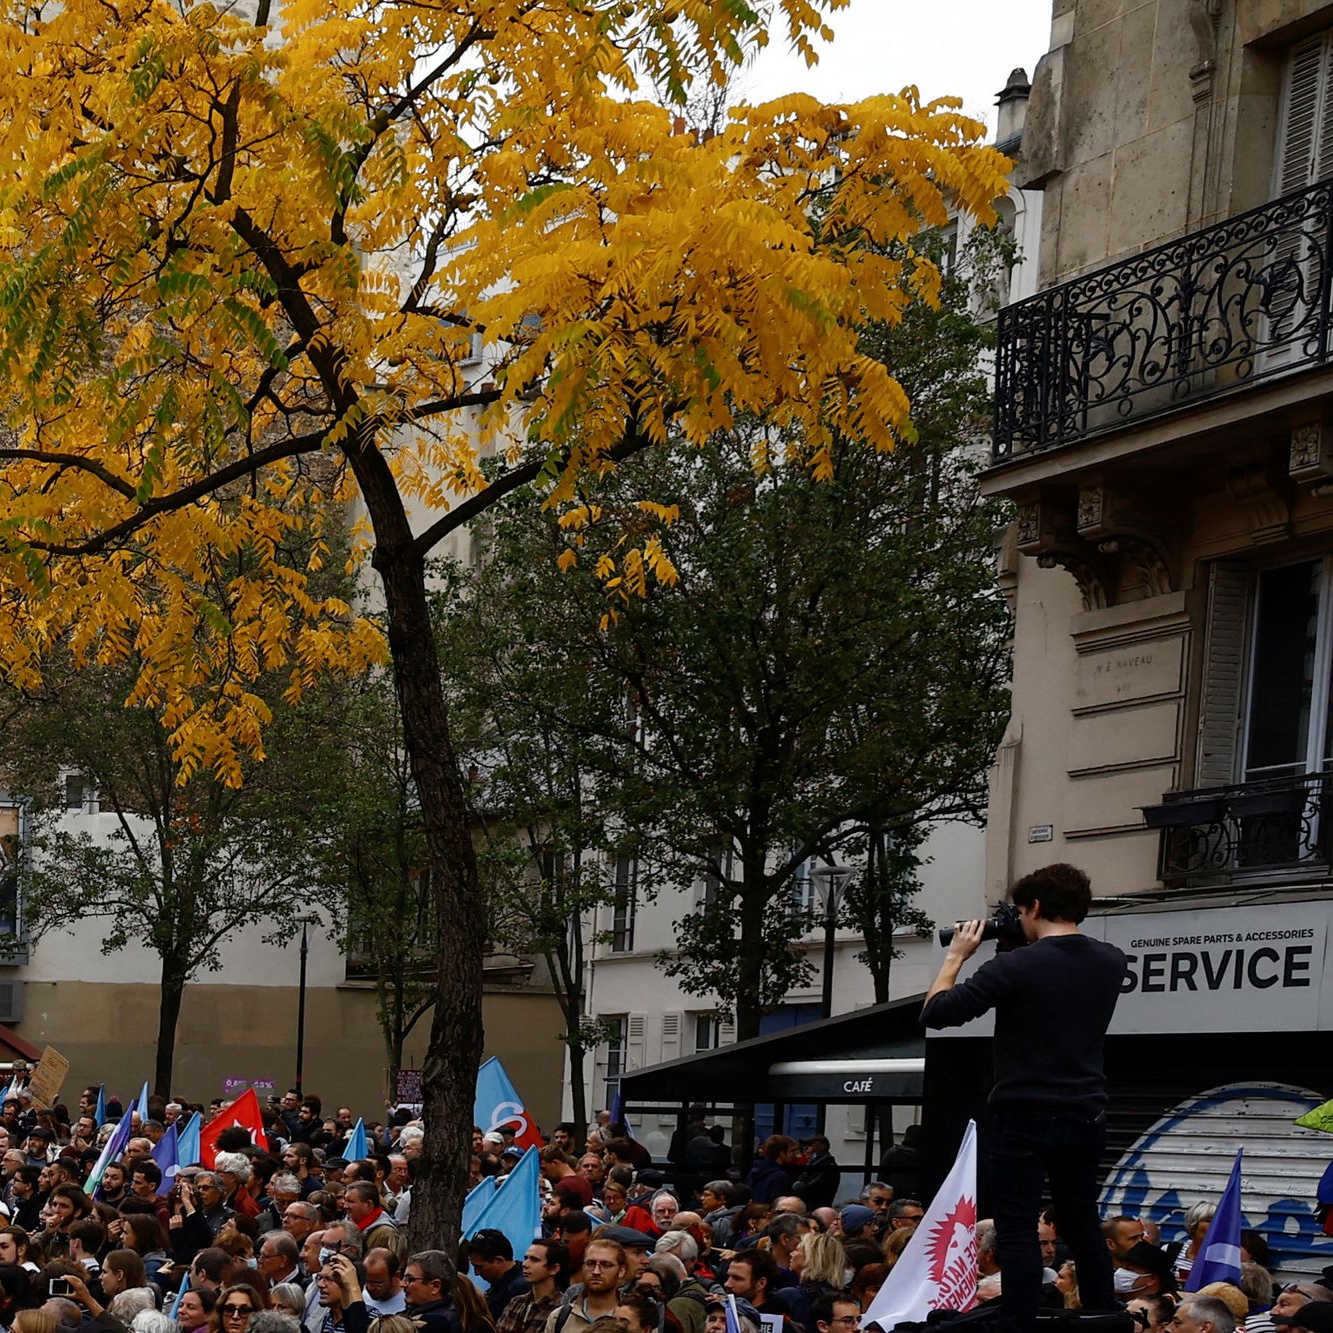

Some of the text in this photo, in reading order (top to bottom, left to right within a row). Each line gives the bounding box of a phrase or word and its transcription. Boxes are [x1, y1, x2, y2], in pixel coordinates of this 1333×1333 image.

[1130, 929, 1315, 949] GENUINE SPARE PARTS & ACCESSORIES
[1119, 944, 1313, 994] SERVICE
[843, 1076, 873, 1093] CAFÉ
